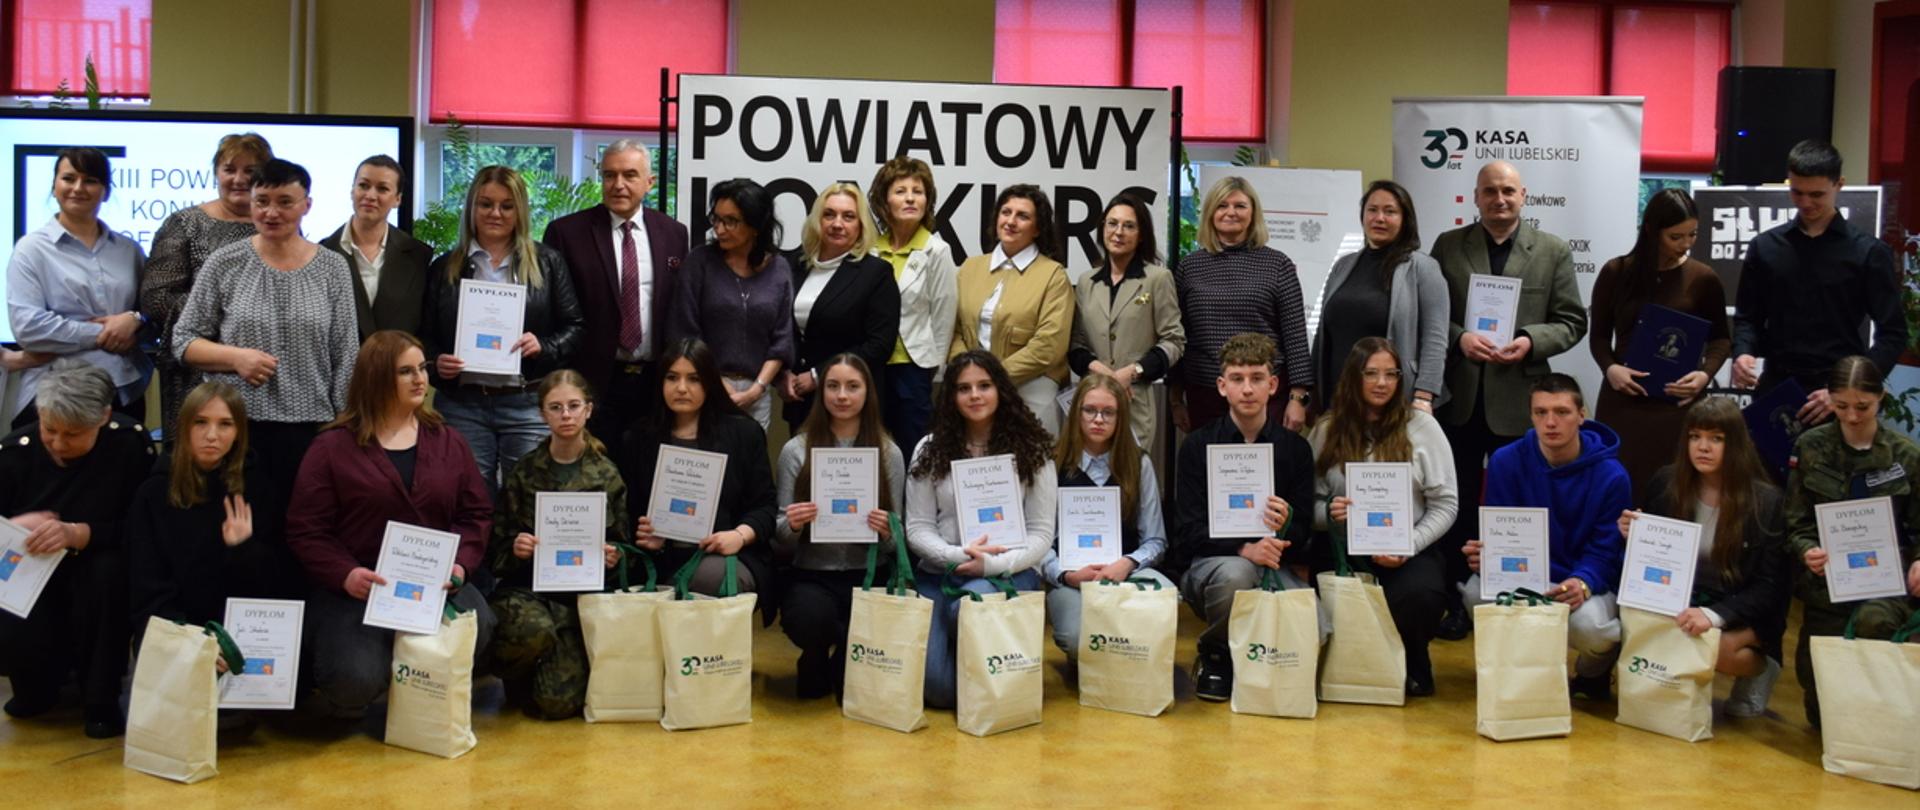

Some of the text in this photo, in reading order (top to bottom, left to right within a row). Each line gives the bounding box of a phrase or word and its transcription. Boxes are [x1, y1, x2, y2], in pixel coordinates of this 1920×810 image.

[691, 93, 1155, 171] POWIATOWY
[1475, 130, 1530, 145] KASA
[1475, 147, 1580, 162] UNII LUBELSKIEJ
[469, 287, 518, 298] DYPLOM
[673, 457, 710, 470] DYPLOM
[827, 456, 863, 465] DYPLOM
[967, 465, 1002, 475] DYPLOM
[1362, 471, 1397, 479] DYPLOM
[1073, 495, 1106, 503] DYPLOM
[1835, 508, 1875, 519] DYPLOM
[1647, 523, 1684, 537] DYPLOM
[402, 535, 441, 549] DYPLOM
[244, 609, 285, 618] DYPLOM
[1108, 636, 1130, 644] KASA
[703, 654, 723, 664] KASA
